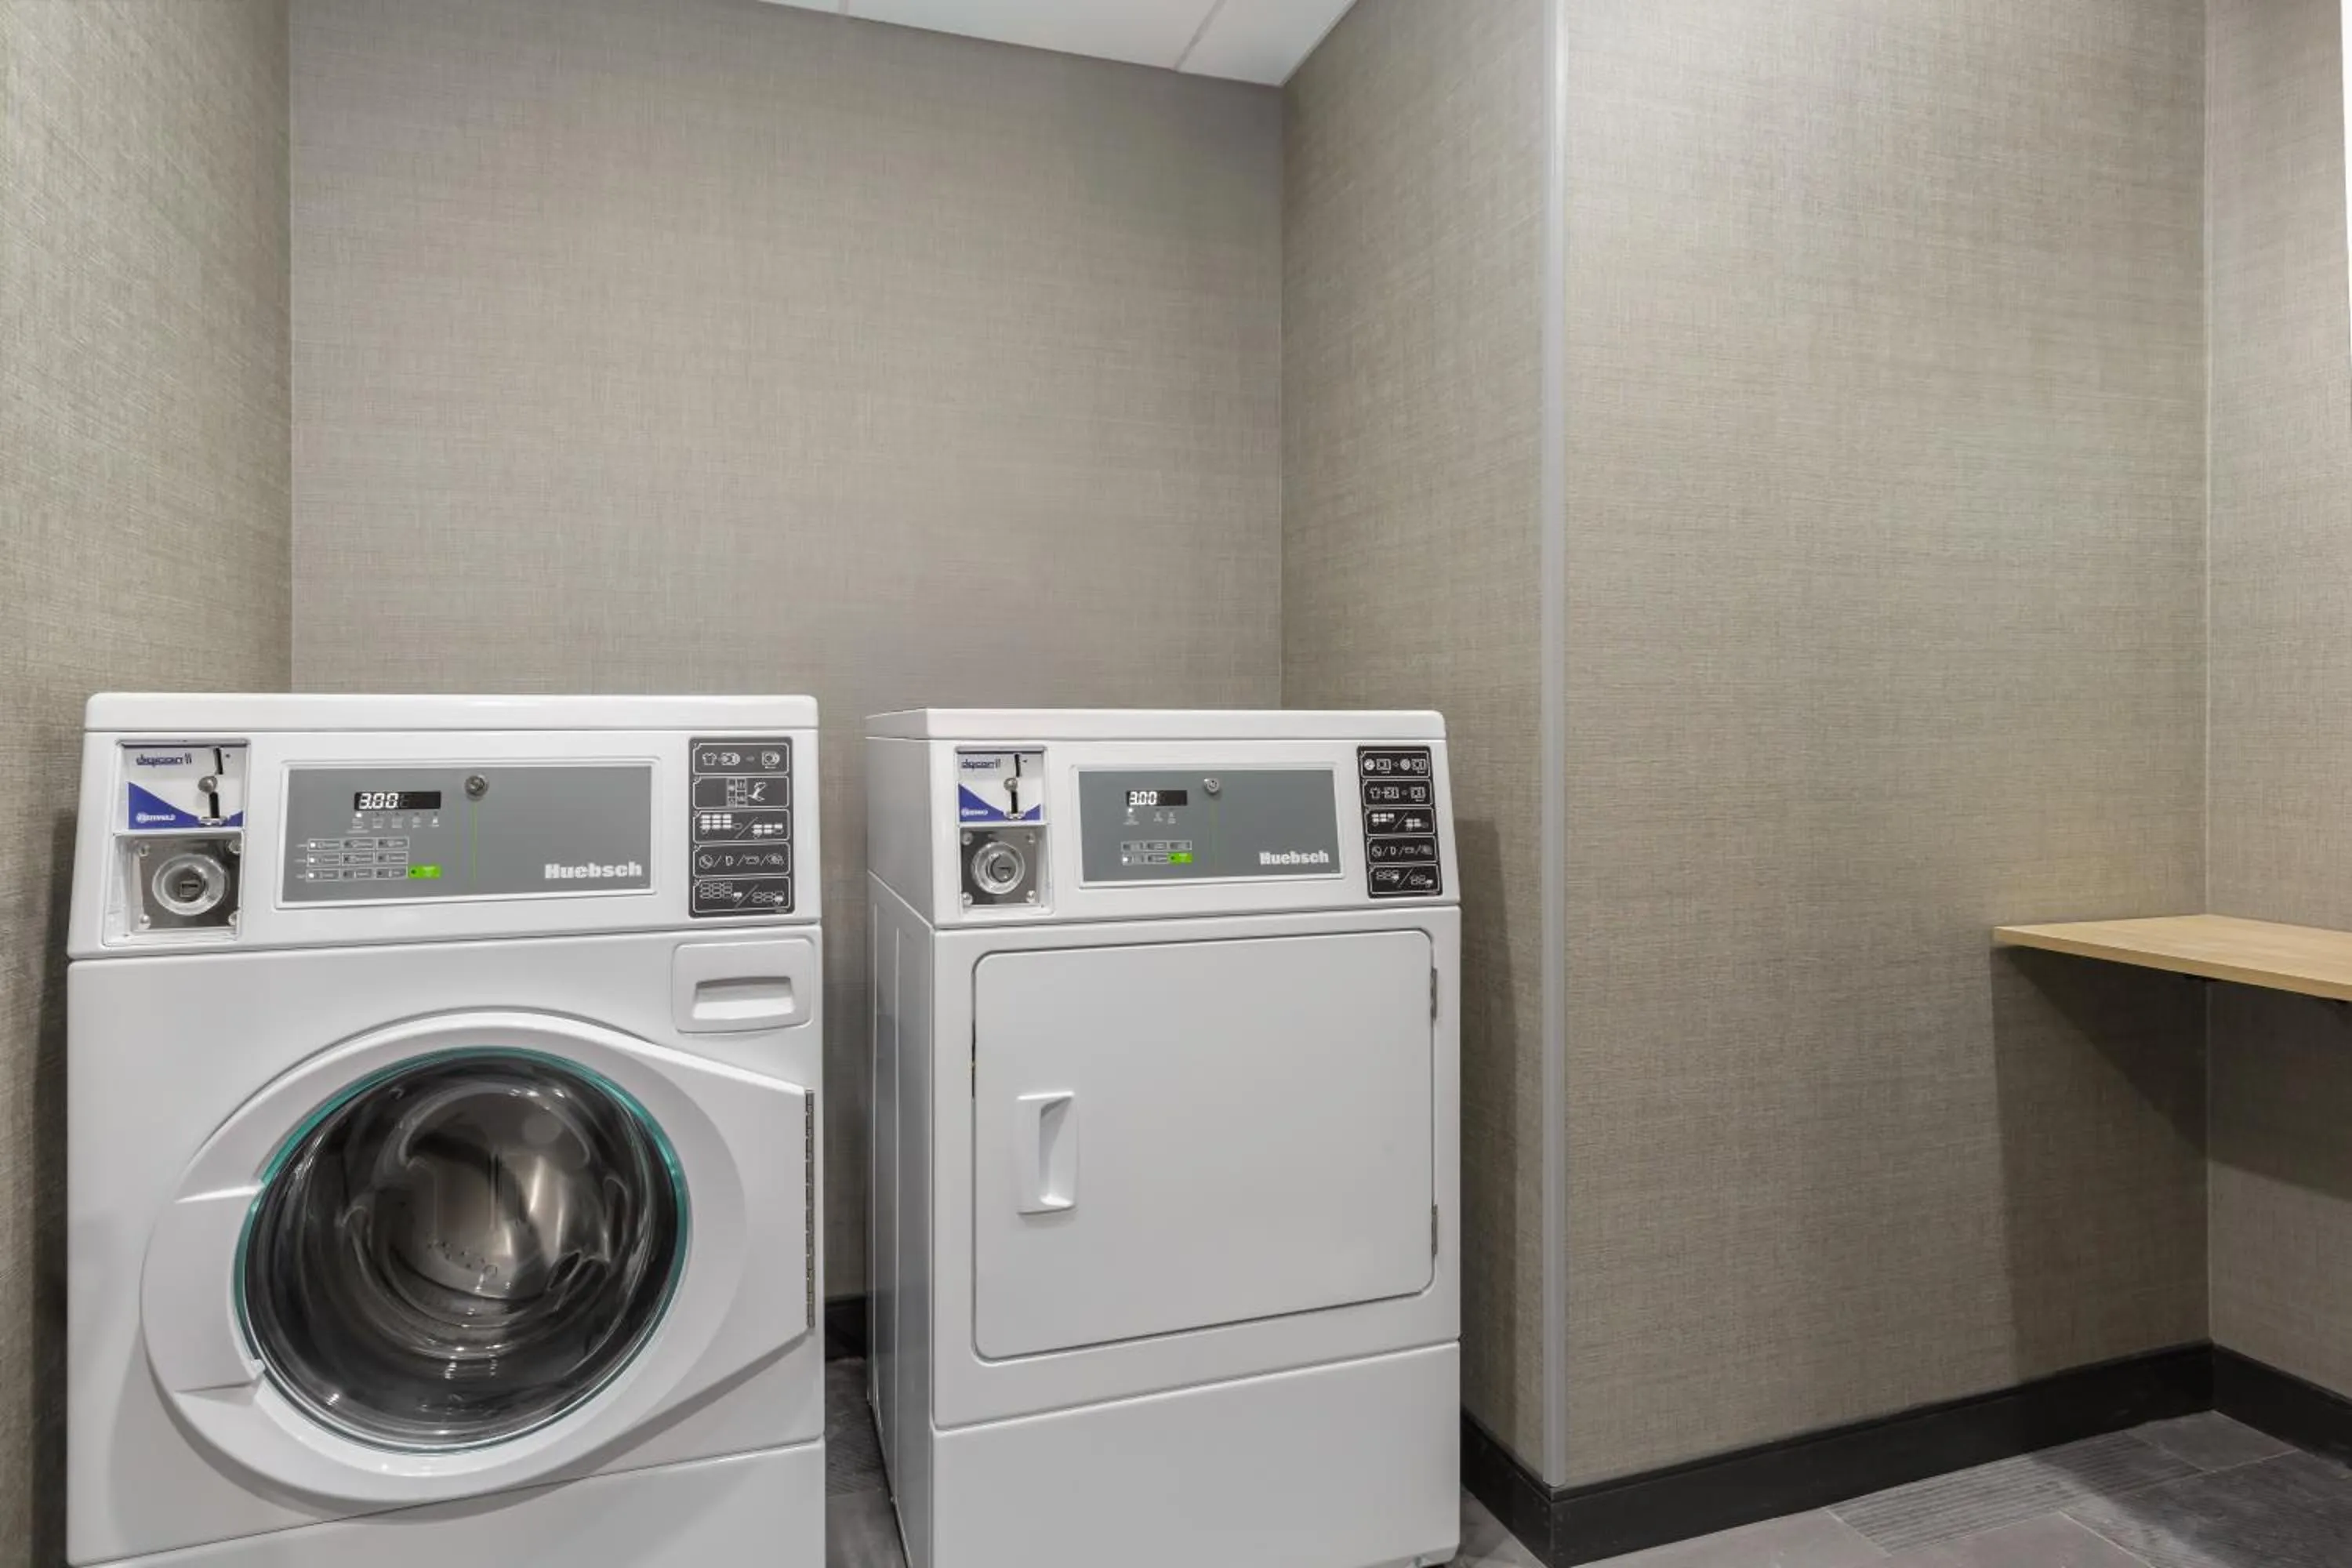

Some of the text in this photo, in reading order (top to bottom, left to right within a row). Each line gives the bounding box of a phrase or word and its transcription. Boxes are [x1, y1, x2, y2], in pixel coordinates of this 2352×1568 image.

[359, 792, 398, 809] 3.00
[1258, 850, 1330, 866] Huebsch
[544, 861, 643, 879] Huebsch
